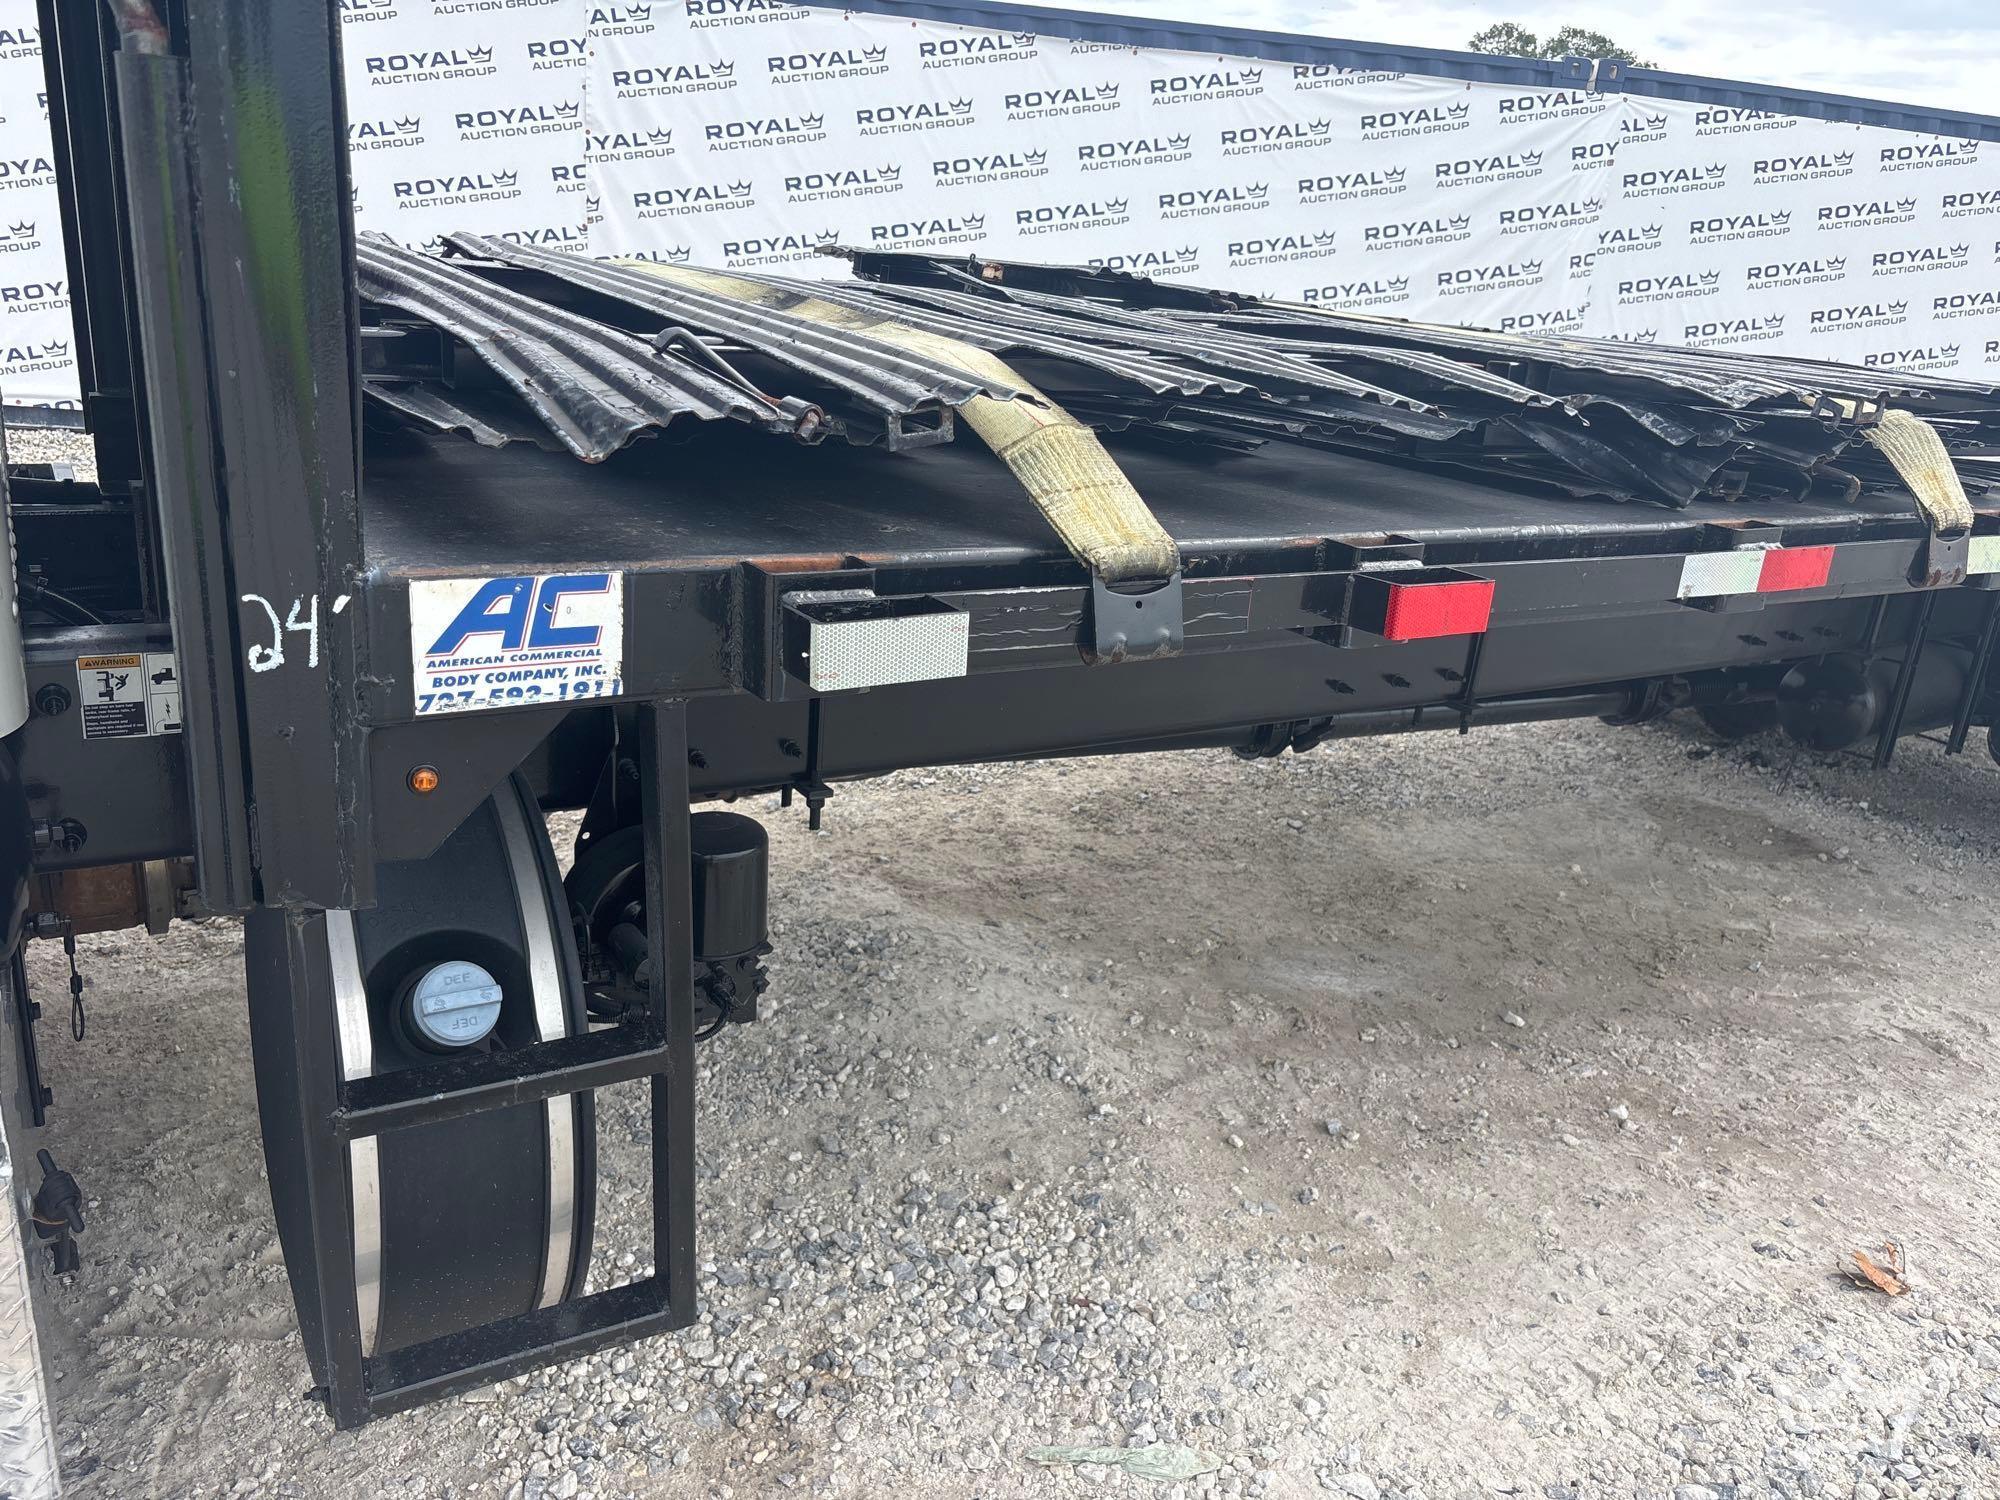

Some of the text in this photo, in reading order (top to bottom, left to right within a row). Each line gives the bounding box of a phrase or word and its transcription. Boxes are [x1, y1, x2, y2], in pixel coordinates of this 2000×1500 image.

[343, 11, 397, 23] GROUP
[434, 1, 502, 15] AUCTION
[690, 10, 810, 29] AUCTION GROUP
[602, 25, 655, 36] GROUP
[528, 38, 586, 58] ROY
[920, 35, 1012, 57] ROYAL
[366, 50, 467, 73] ROYAL
[768, 50, 862, 72] ROYAL
[923, 50, 1037, 69] AUCTION GROUP
[372, 66, 496, 86] AUCTION GROUP
[613, 65, 710, 86] ROYAL
[772, 65, 889, 84] AUCTION GROUP
[1150, 72, 1239, 94] ROYAL
[1295, 73, 1404, 91] AUCTION GROUP
[617, 80, 737, 99] AUCTION GROUP
[1005, 87, 1095, 109] ROYAL
[1153, 87, 1263, 105] AUCTION GROUP
[1008, 102, 1120, 120] AUCTION GROUP
[1499, 91, 1584, 113] ROYAL
[455, 106, 555, 128] ROYAL
[857, 102, 949, 124] ROYAL
[1361, 108, 1446, 130] ROYAL
[1500, 105, 1605, 125] AUCTION GROUP
[461, 122, 582, 141] AUCTION GROUP
[705, 118, 800, 140] ROYAL
[860, 117, 975, 136] AUCTION GROUP
[1221, 123, 1308, 145] ROYAL
[1362, 122, 1469, 141] AUCTION GROUP
[1696, 120, 1797, 136] AUCTION GROUP
[371, 137, 424, 149] GROUP
[709, 133, 826, 151] AUCTION GROUP
[1223, 138, 1331, 156] AUCTION GROUP
[1623, 133, 1667, 144] GROUP
[624, 148, 675, 160] GROUP
[1079, 138, 1167, 160] ROYAL
[1881, 143, 1957, 162] ROYAL
[933, 154, 1023, 176] ROYAL
[1081, 153, 1191, 171] AUCTION GROUP
[1436, 155, 1520, 177] ROYAL
[1754, 155, 1832, 174] ROYAL
[1880, 157, 1977, 172] AUCTION GROUP
[394, 175, 493, 197] ROYAL
[785, 169, 877, 191] ROYAL
[936, 168, 1048, 187] AUCTION GROUP
[1298, 172, 1383, 193] ROYAL
[1436, 169, 1542, 188] AUCTION GROUP
[1623, 167, 1704, 188] ROYAL
[1754, 169, 1853, 184] AUCTION GROUP
[399, 190, 521, 209] AUCTION GROUP
[634, 185, 728, 207] ROYAL
[788, 184, 903, 203] AUCTION GROUP
[1159, 187, 1245, 208] ROYAL
[1300, 185, 1406, 204] AUCTION GROUP
[1623, 181, 1725, 199] AUCTION GROUP
[1942, 190, 2000, 208] ROYA
[638, 200, 755, 219] AUCTION GROUP
[1016, 203, 1105, 224] ROYAL
[1161, 201, 1269, 219] AUCTION GROUP
[1500, 202, 1581, 224] ROYAL
[1818, 201, 1895, 220] ROYAL
[1942, 207, 1994, 218] AUCTION
[871, 219, 961, 240] ROYAL
[1019, 216, 1129, 235] AUCTION GROUP
[1365, 219, 1448, 241] ROYAL
[1500, 215, 1599, 235] AUCTION GROUP
[1690, 214, 1769, 234] ROYAL
[1818, 215, 1915, 231] AUCTION GROUP
[723, 234, 815, 256] ROYAL
[876, 232, 987, 250] AUCTION GROUP
[1366, 232, 1471, 251] AUCTION GROUP
[1690, 227, 1790, 244] AUCTION GROUP
[1228, 235, 1313, 256] ROYAL
[1618, 241, 1661, 252] GROUP
[727, 254, 789, 268] AUCTION
[1230, 249, 1336, 267] AUCTION GROUP
[1873, 247, 1948, 266] ROYAL
[1153, 264, 1199, 276] GROUP
[1438, 264, 1520, 286] ROYAL
[1747, 260, 1825, 280] ROYAL
[1872, 260, 1968, 276] AUCTION GROUP
[1439, 277, 1543, 296] AUCTION GROUP
[1619, 274, 1698, 295] ROYAL
[1747, 273, 1845, 290] AUCTION GROUP
[1304, 281, 1386, 302] ROYAL
[1365, 294, 1409, 305] GROUP
[1619, 287, 1719, 304] AUCTION GROUP
[1934, 292, 2000, 310] ROYA
[1501, 309, 1576, 331] ROYAL
[1811, 304, 1886, 323] ROYAL
[1933, 308, 1984, 320] AUCTION
[1685, 318, 1763, 338] ROYAL
[1810, 317, 1906, 333] AUCTION GROUP
[1685, 331, 1783, 348] AUCTION GROUP
[20, 360, 73, 372] GROUP
[1864, 348, 1939, 366] ROYAL
[1918, 360, 1959, 371] GROUP
[425, 574, 612, 657] AC
[92, 658, 135, 667] WARNING
[426, 649, 603, 668] AMERICAN COMMERCIAL
[432, 665, 607, 688] BODY COMPANY, INC.
